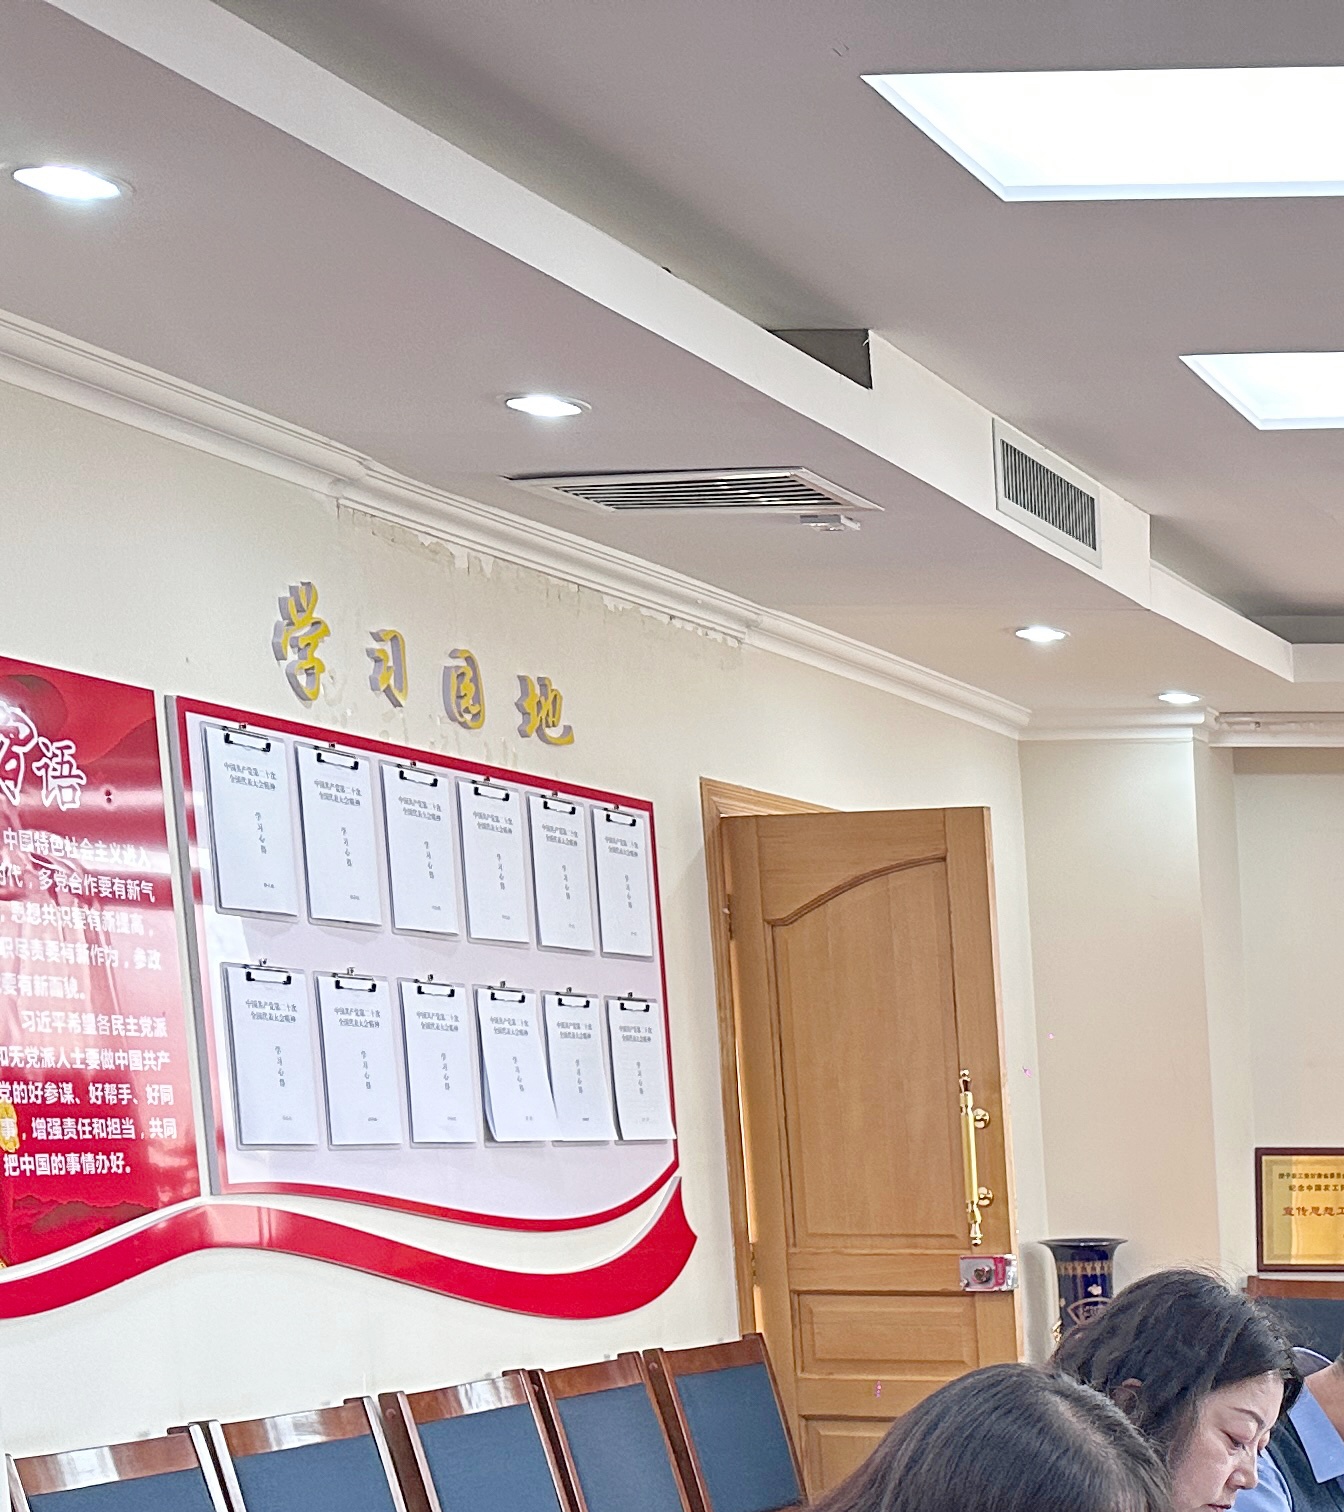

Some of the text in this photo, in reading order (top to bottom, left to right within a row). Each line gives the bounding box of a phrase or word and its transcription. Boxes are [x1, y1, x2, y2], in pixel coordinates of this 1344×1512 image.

[272, 582, 576, 746] 学习园地
[3, 828, 152, 868] 中国特色社会主义进入
[21, 1010, 168, 1038] 习近平希望各民主党派
[4, 1152, 131, 1177] 把中国的事情办好。
